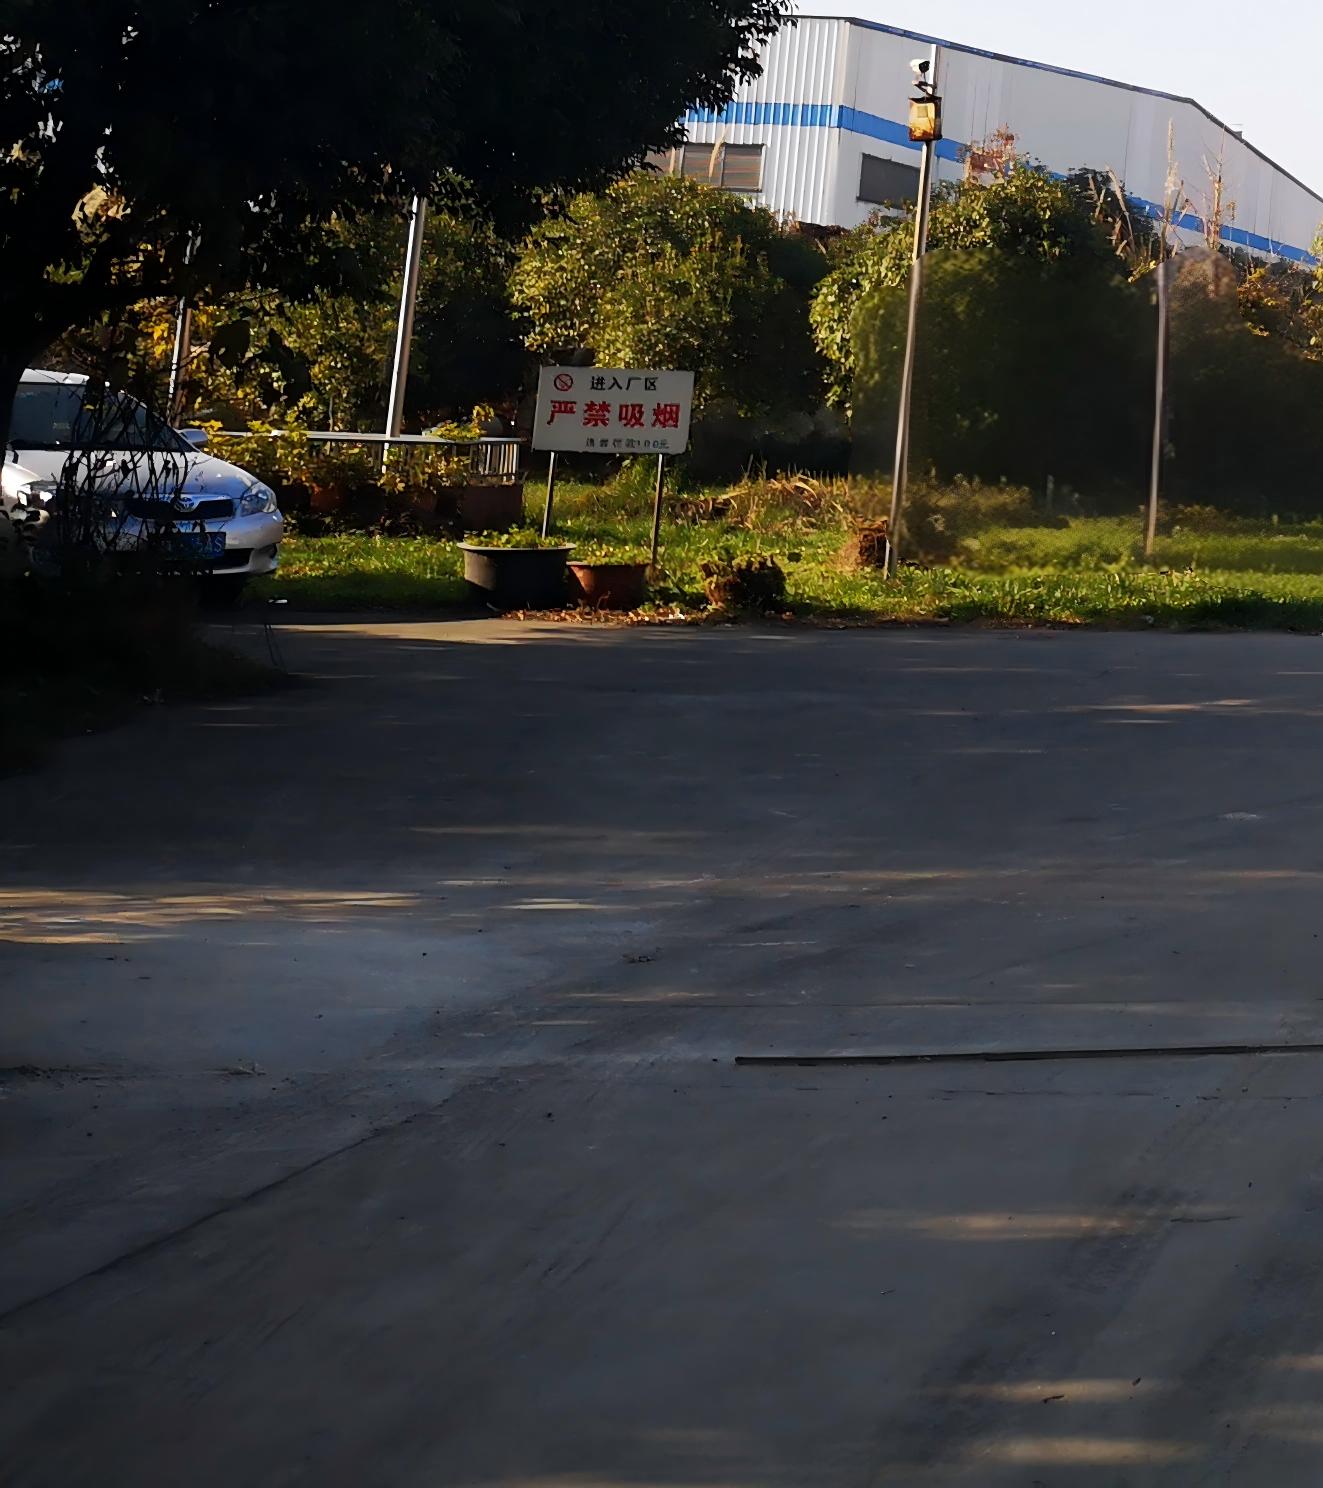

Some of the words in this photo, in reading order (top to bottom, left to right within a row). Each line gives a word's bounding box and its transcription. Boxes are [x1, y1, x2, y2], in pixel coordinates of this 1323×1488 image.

[590, 375, 659, 391] 进入厂区
[546, 399, 681, 429] 严禁吸烟
